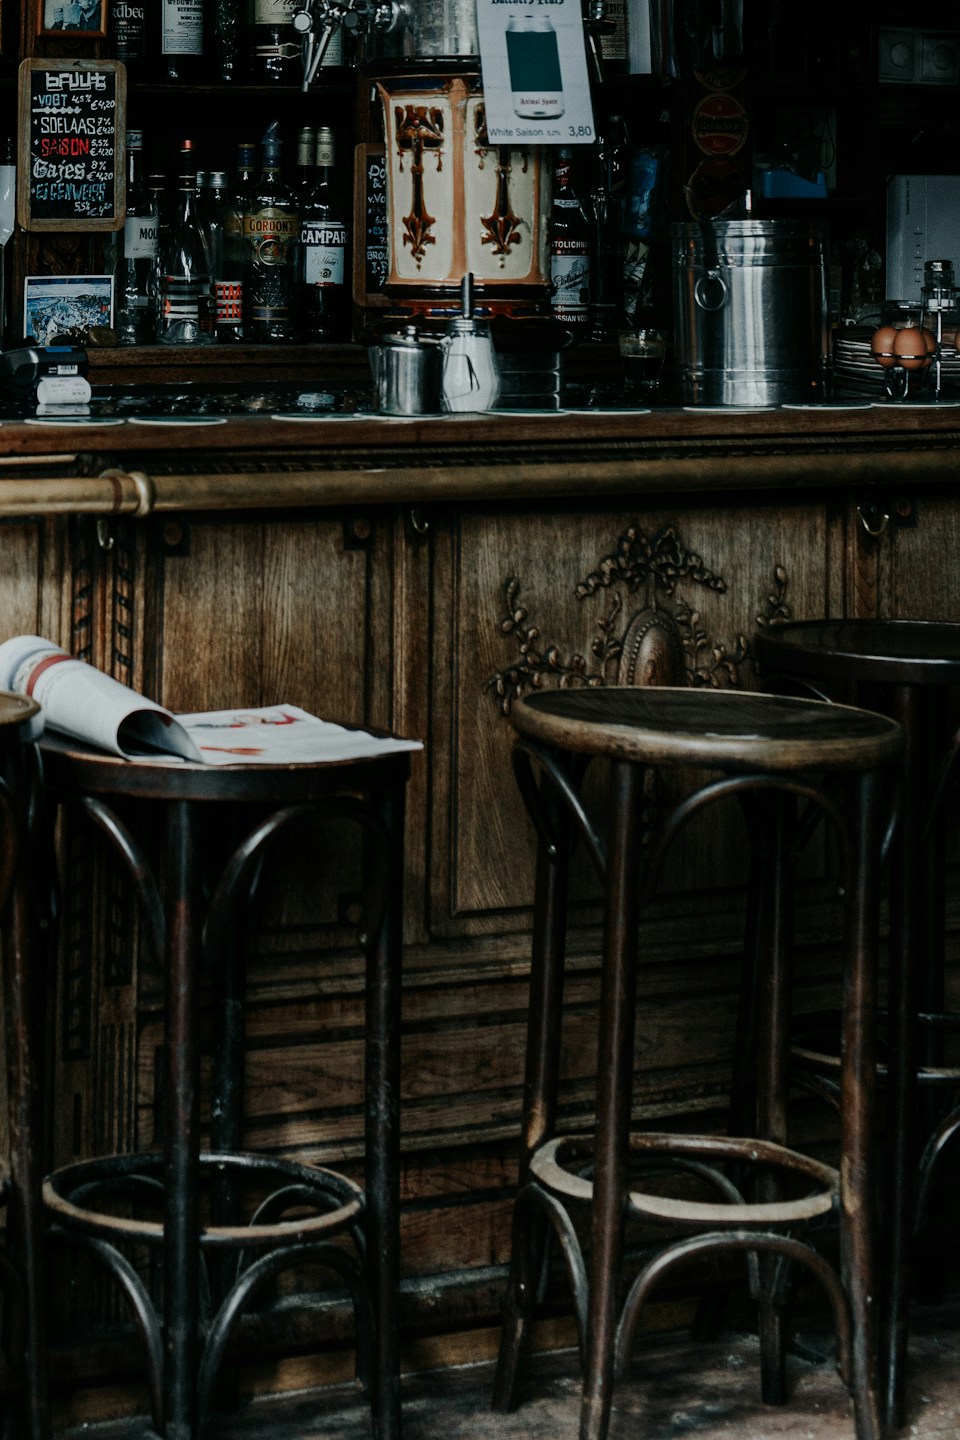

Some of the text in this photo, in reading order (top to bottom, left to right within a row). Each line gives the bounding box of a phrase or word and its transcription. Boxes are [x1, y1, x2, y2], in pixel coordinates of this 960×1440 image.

[91, 100, 116, 111] €4,20
[97, 117, 112, 126] 7%
[490, 126, 592, 137] White Saison 3,80
[91, 160, 107, 171] 8%
[249, 218, 294, 233] GORDON'S
